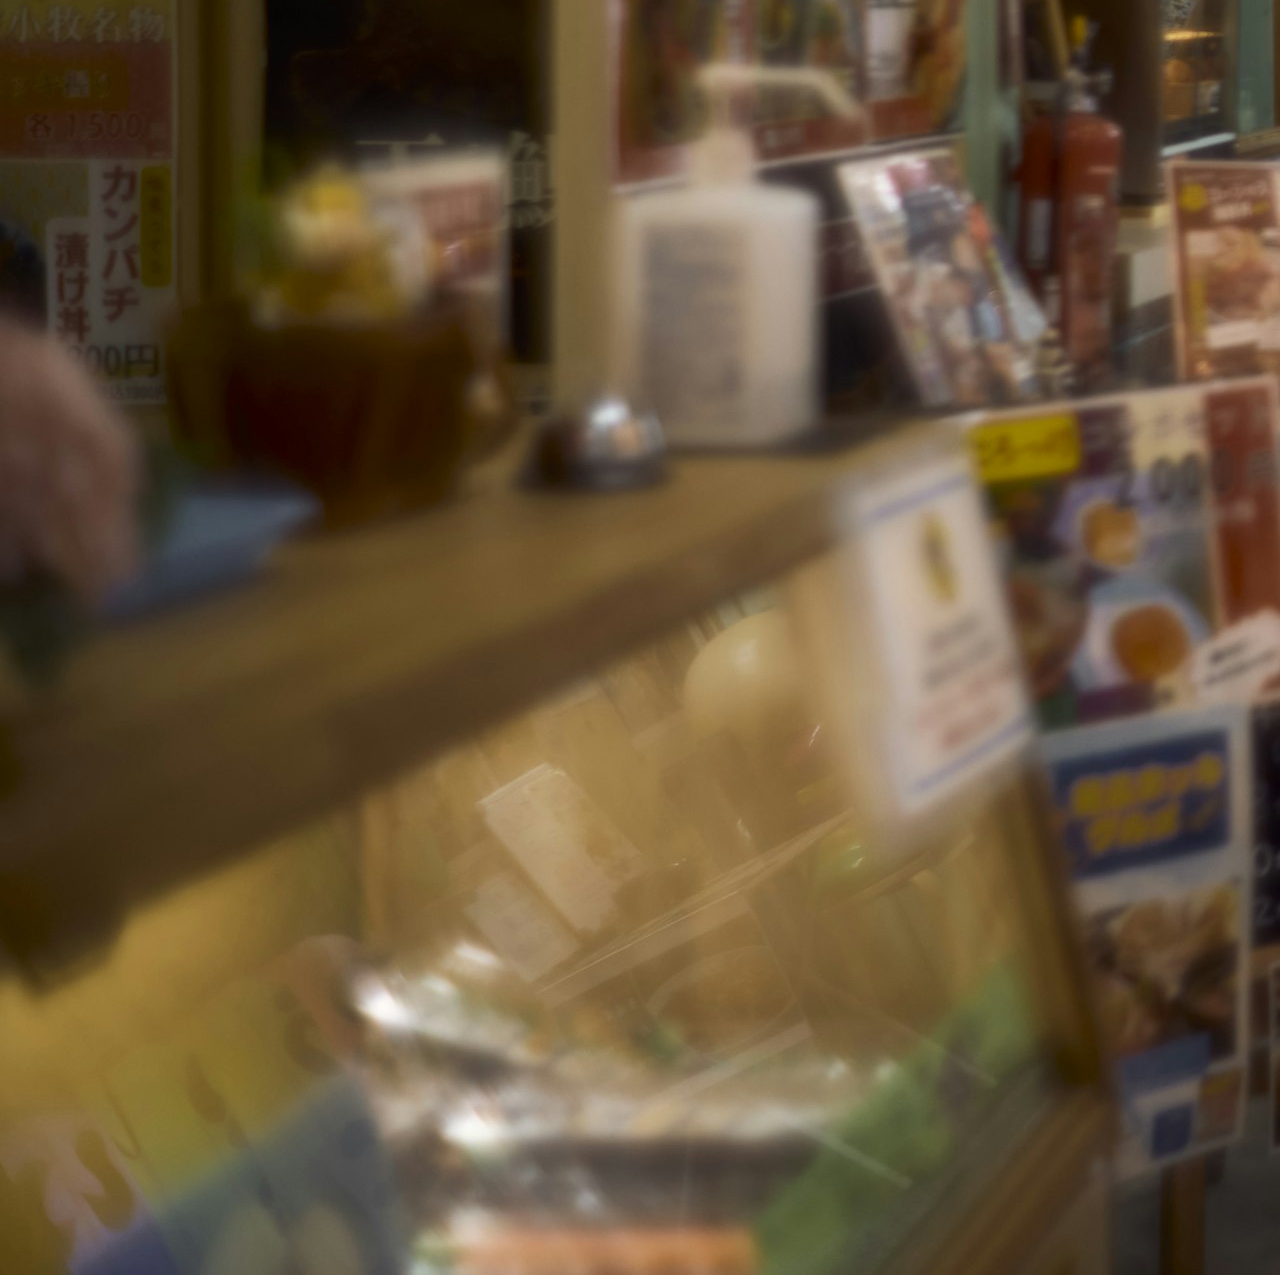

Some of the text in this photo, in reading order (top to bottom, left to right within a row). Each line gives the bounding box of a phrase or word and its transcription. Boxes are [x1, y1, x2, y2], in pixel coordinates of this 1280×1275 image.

[2, 6, 165, 44] 小牧名物
[54, 232, 91, 344] 漬け丼
[101, 165, 139, 322] カンパチ
